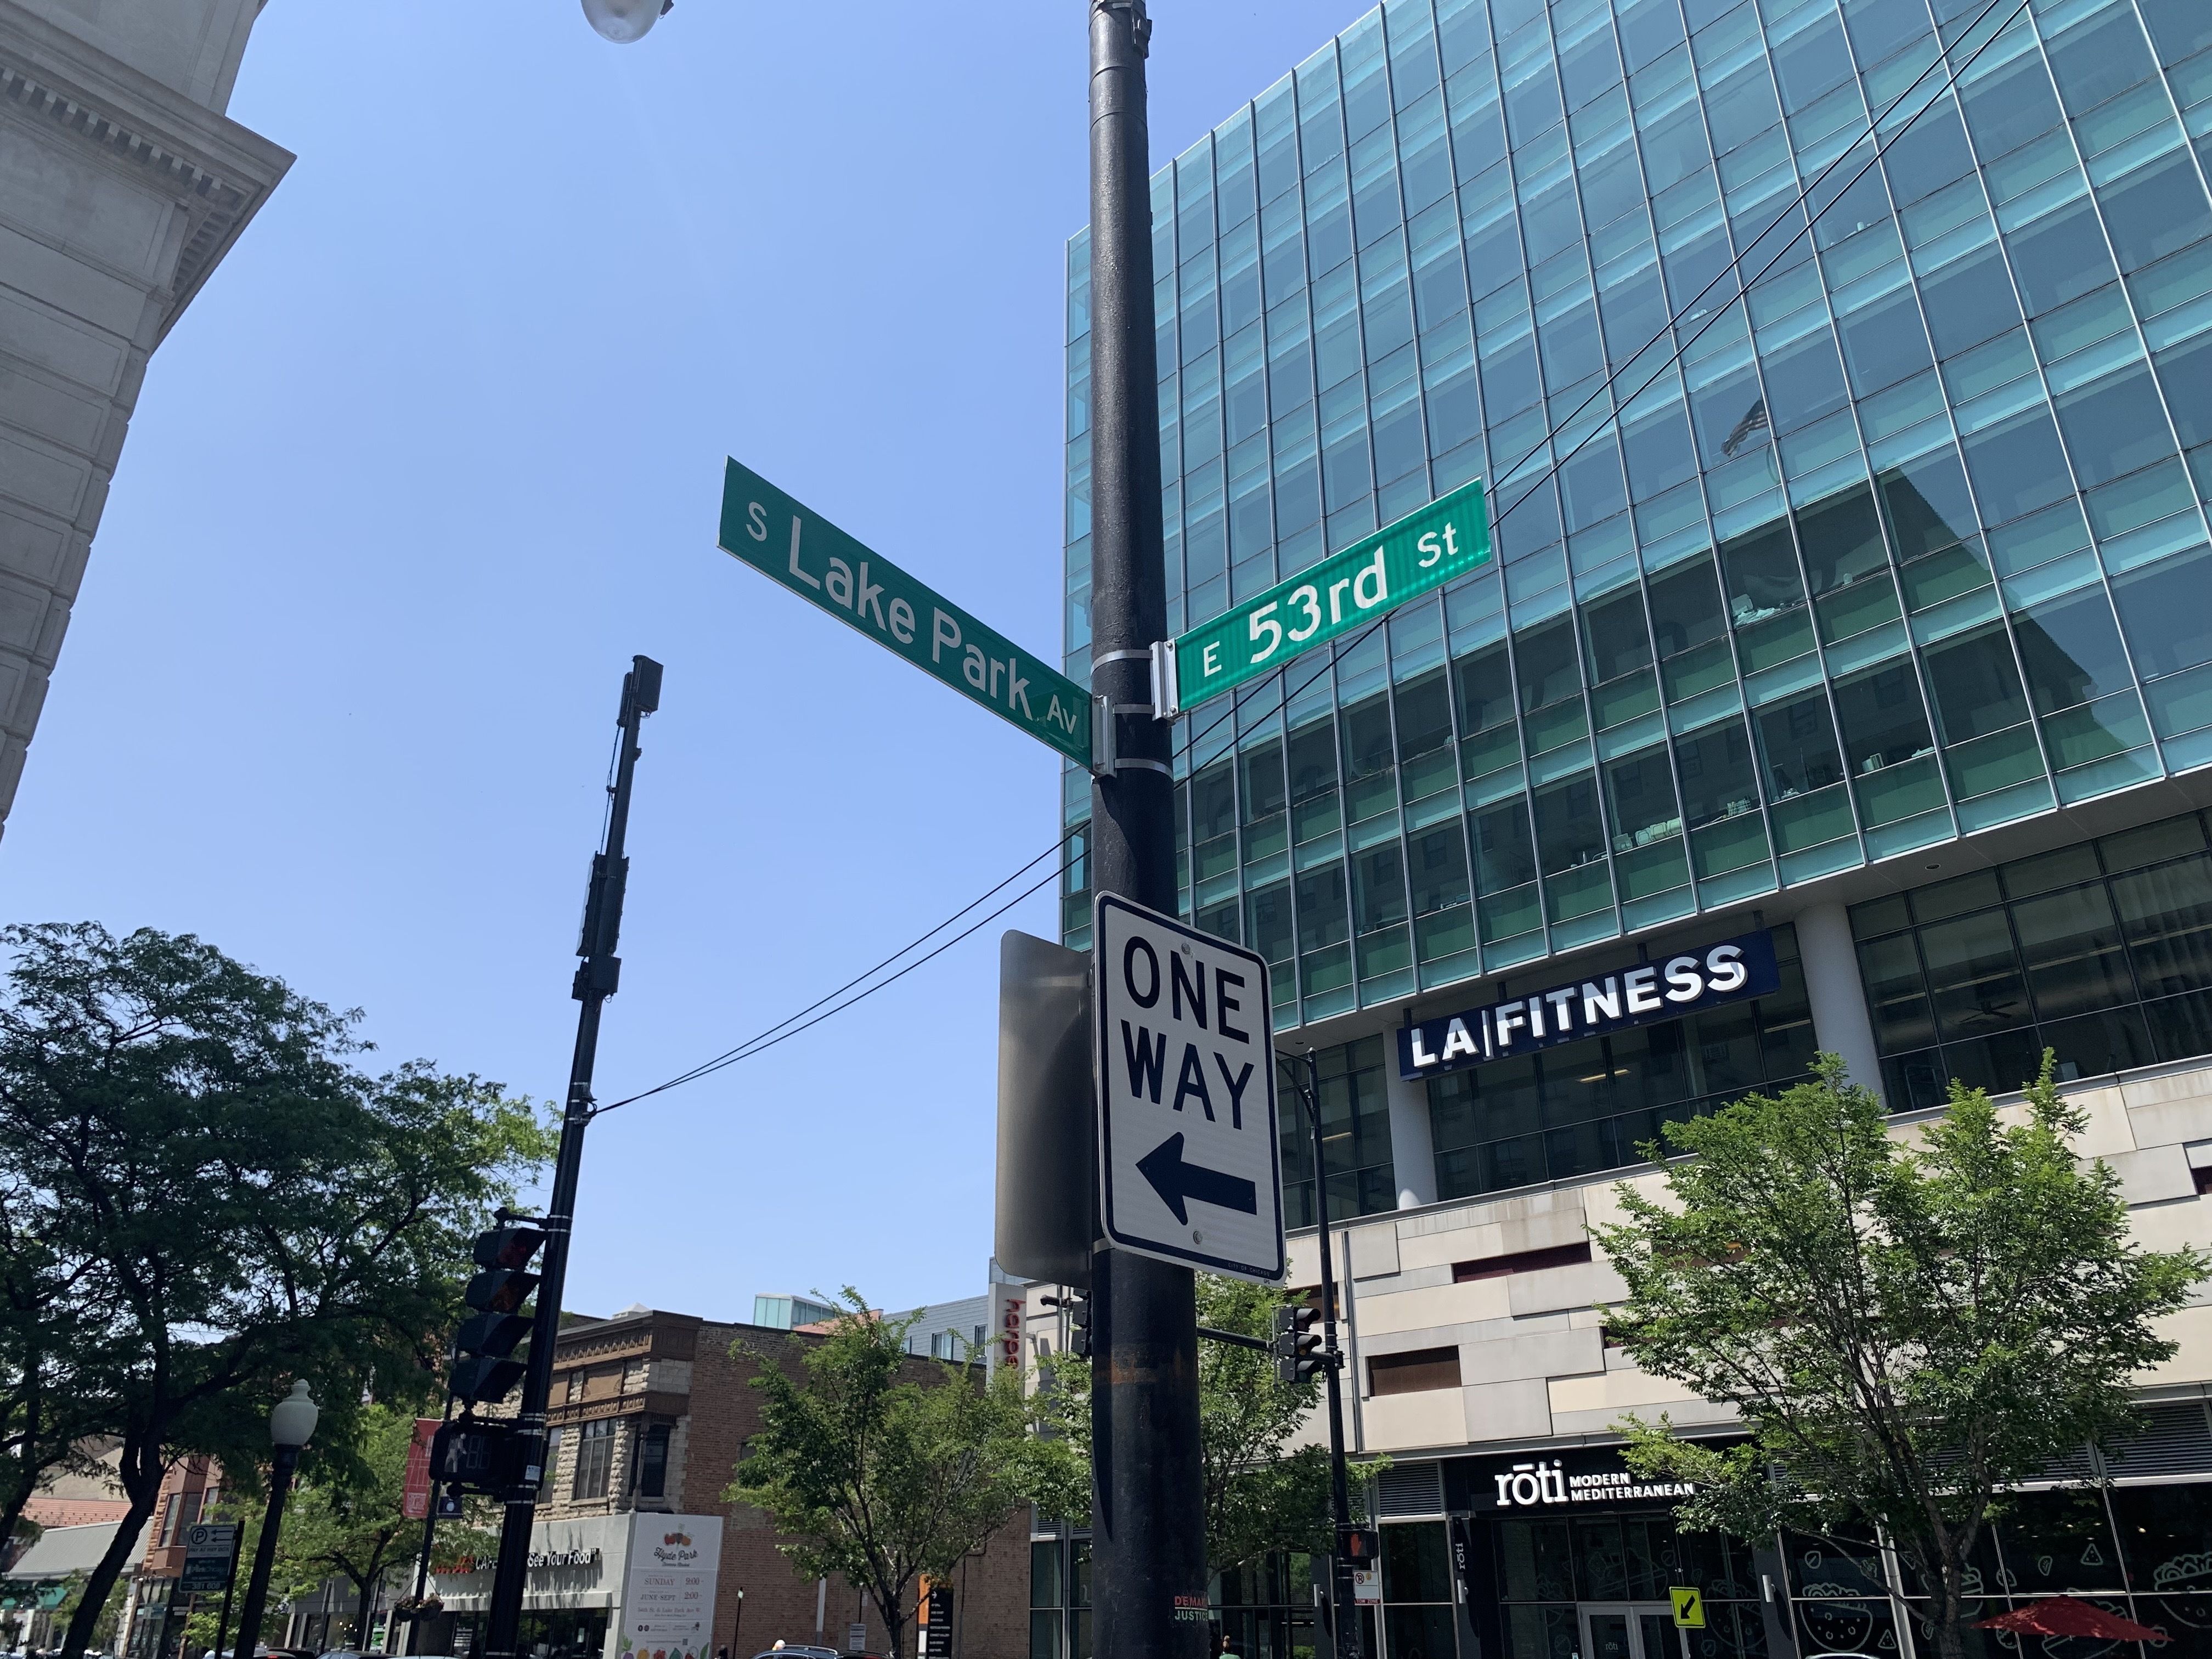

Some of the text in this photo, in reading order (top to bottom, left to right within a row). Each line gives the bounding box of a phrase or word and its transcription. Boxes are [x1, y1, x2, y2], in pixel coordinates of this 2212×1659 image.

[1203, 522, 1458, 678] E 53rd St
[746, 501, 767, 541] S
[789, 515, 916, 644] Lake
[932, 607, 1033, 721] Park
[1124, 936, 1250, 1045] ONE
[1120, 1019, 1255, 1131] WAY
[1249, 1267, 1270, 1277] CHICAGO
[1569, 1472, 1631, 1488] MODERN
[1570, 1482, 1696, 1502] MEDITERRANEAN
[527, 1551, 544, 1567] See
[546, 1551, 567, 1566] Your
[653, 1547, 698, 1562] Hyde Park
[644, 1578, 675, 1586] SUNDAY
[1174, 1595, 1207, 1607] DEMAN
